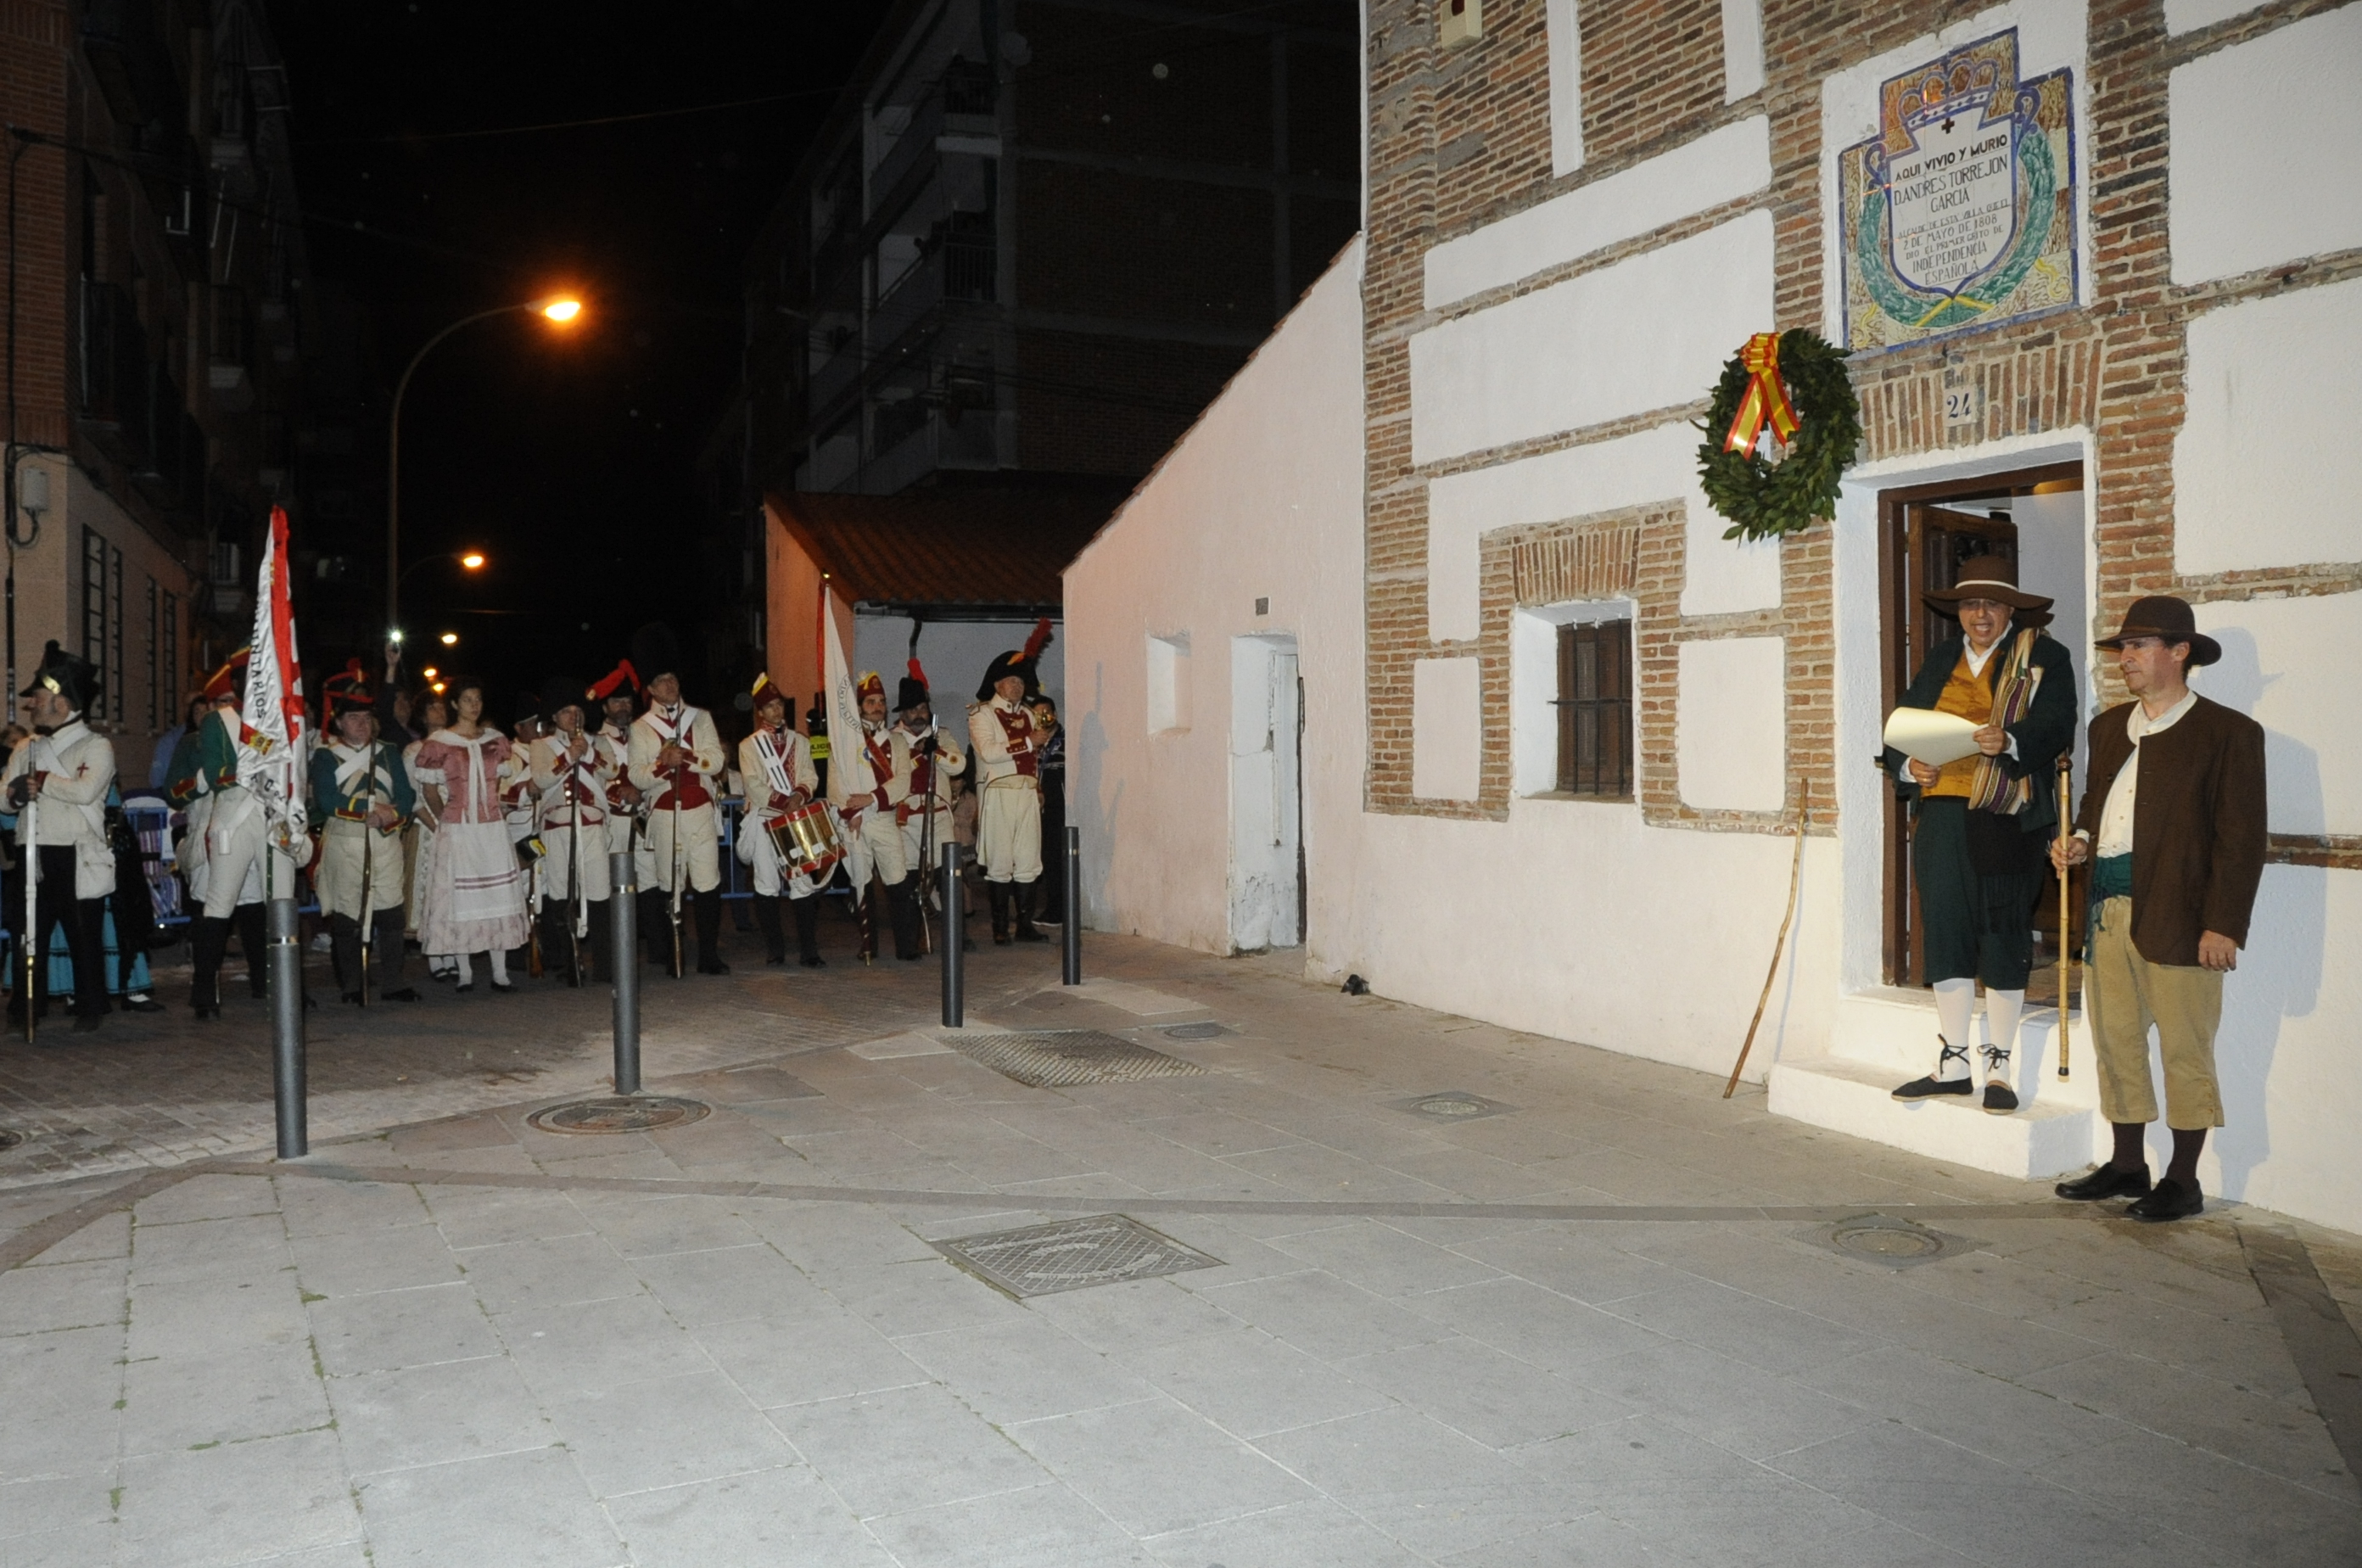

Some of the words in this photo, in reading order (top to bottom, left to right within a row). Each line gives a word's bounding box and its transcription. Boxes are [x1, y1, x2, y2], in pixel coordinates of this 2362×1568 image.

[1895, 164, 1920, 182] AQUI
[1924, 152, 1955, 170] VIVIO
[1959, 147, 1967, 160] Y
[1970, 134, 2007, 157] MURIO
[1949, 154, 2007, 188] TORREJON
[1931, 188, 1970, 213] GARCIA
[1898, 224, 1926, 238] ALCALDE
[1929, 221, 1939, 230] DE
[1940, 215, 1959, 227] ESTA
[1986, 202, 1998, 212] QUE
[2000, 199, 2011, 210] EL
[1904, 240, 1909, 250] 2
[1911, 235, 1923, 248] DE
[1927, 227, 1954, 243] MAYO
[1958, 221, 1971, 234] DE
[1973, 213, 1997, 229] 1808
[1906, 250, 1919, 260] DIO
[1925, 245, 1934, 255] EL
[1936, 236, 1966, 251] PRIMER
[1967, 229, 1990, 241] GRITO
[1994, 225, 2003, 234] DE
[1912, 241, 1987, 273] INDEPENDENCIA
[1925, 260, 1979, 285] ESPAÑOLA
[1946, 393, 1972, 418] 24
